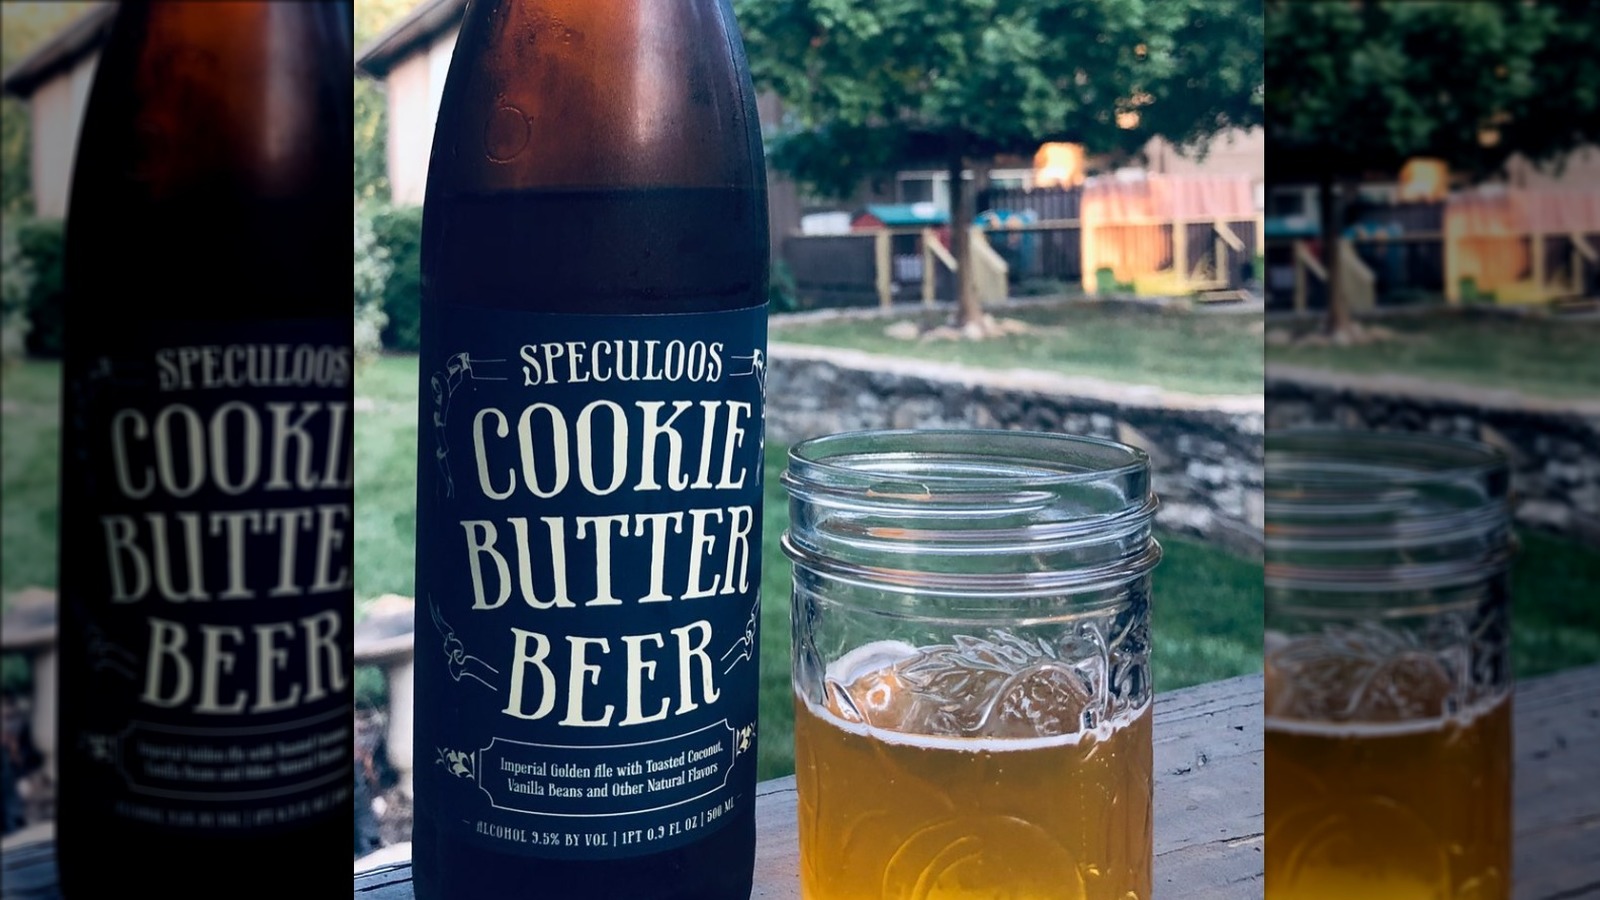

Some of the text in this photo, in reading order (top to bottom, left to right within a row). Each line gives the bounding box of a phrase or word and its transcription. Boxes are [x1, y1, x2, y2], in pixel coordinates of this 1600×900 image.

[155, 344, 350, 392] SPECULOOS
[519, 339, 724, 386] SPECULOOS
[110, 399, 354, 499] COOKI
[473, 399, 751, 500] COOKIE
[100, 502, 353, 605] BUTTE
[460, 505, 753, 610] BUTTER
[137, 608, 350, 716] BEER
[501, 620, 721, 727] BEER
[500, 756, 547, 777] Imperial
[550, 762, 591, 779] Golden
[593, 762, 613, 779] Ale
[616, 760, 643, 777] with
[645, 751, 686, 774] Toasted
[507, 762, 719, 798] Vanilla Beans and Other Natural Flavors
[476, 796, 736, 847] ALCOHOL 9.5% BY VOL 1PT 0.9 FL OZ 500 ML
